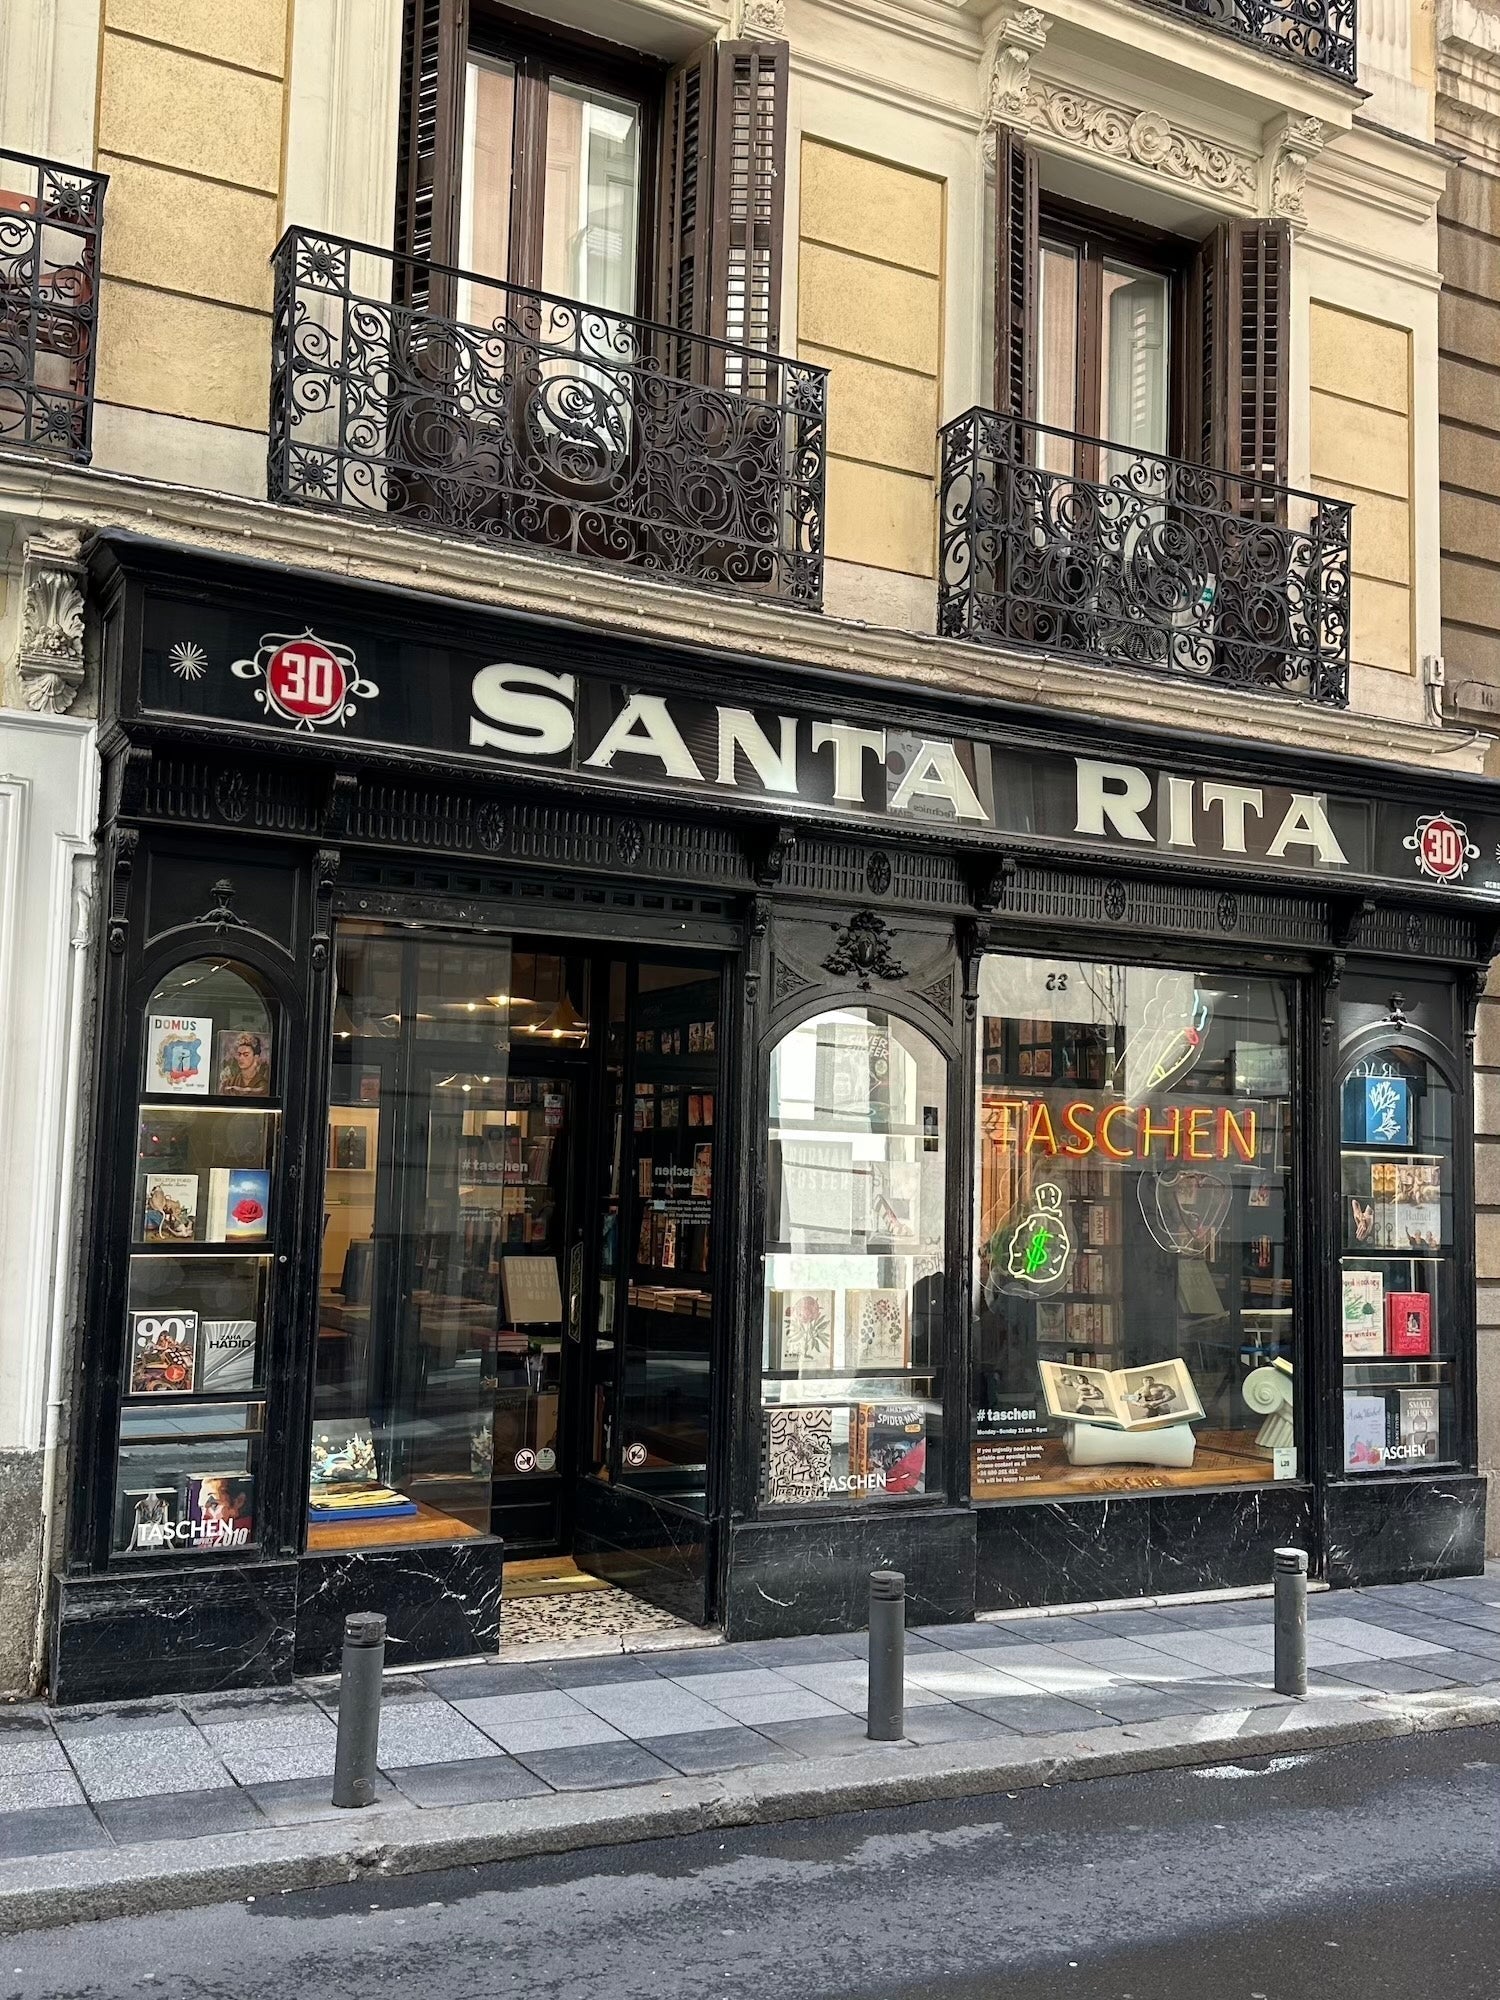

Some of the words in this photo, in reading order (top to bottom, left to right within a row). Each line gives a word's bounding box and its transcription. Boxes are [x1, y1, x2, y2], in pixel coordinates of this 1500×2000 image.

[281, 652, 333, 706] 30
[469, 663, 989, 820] SANTA
[1074, 757, 1349, 864] RITA
[1427, 828, 1456, 866] 30
[155, 1019, 197, 1031] DOMUS
[982, 1100, 1256, 1161] TASCHEN
[137, 1317, 195, 1348] 90s
[209, 1339, 252, 1349] HADID
[976, 1407, 1037, 1422] #taschen
[1406, 1409, 1434, 1418] HOUSES
[1408, 1401, 1432, 1409] SMALL
[1378, 1443, 1426, 1461] TASCHEN
[822, 1472, 887, 1492] TASCHEN
[137, 1517, 234, 1542] TASCHEN
